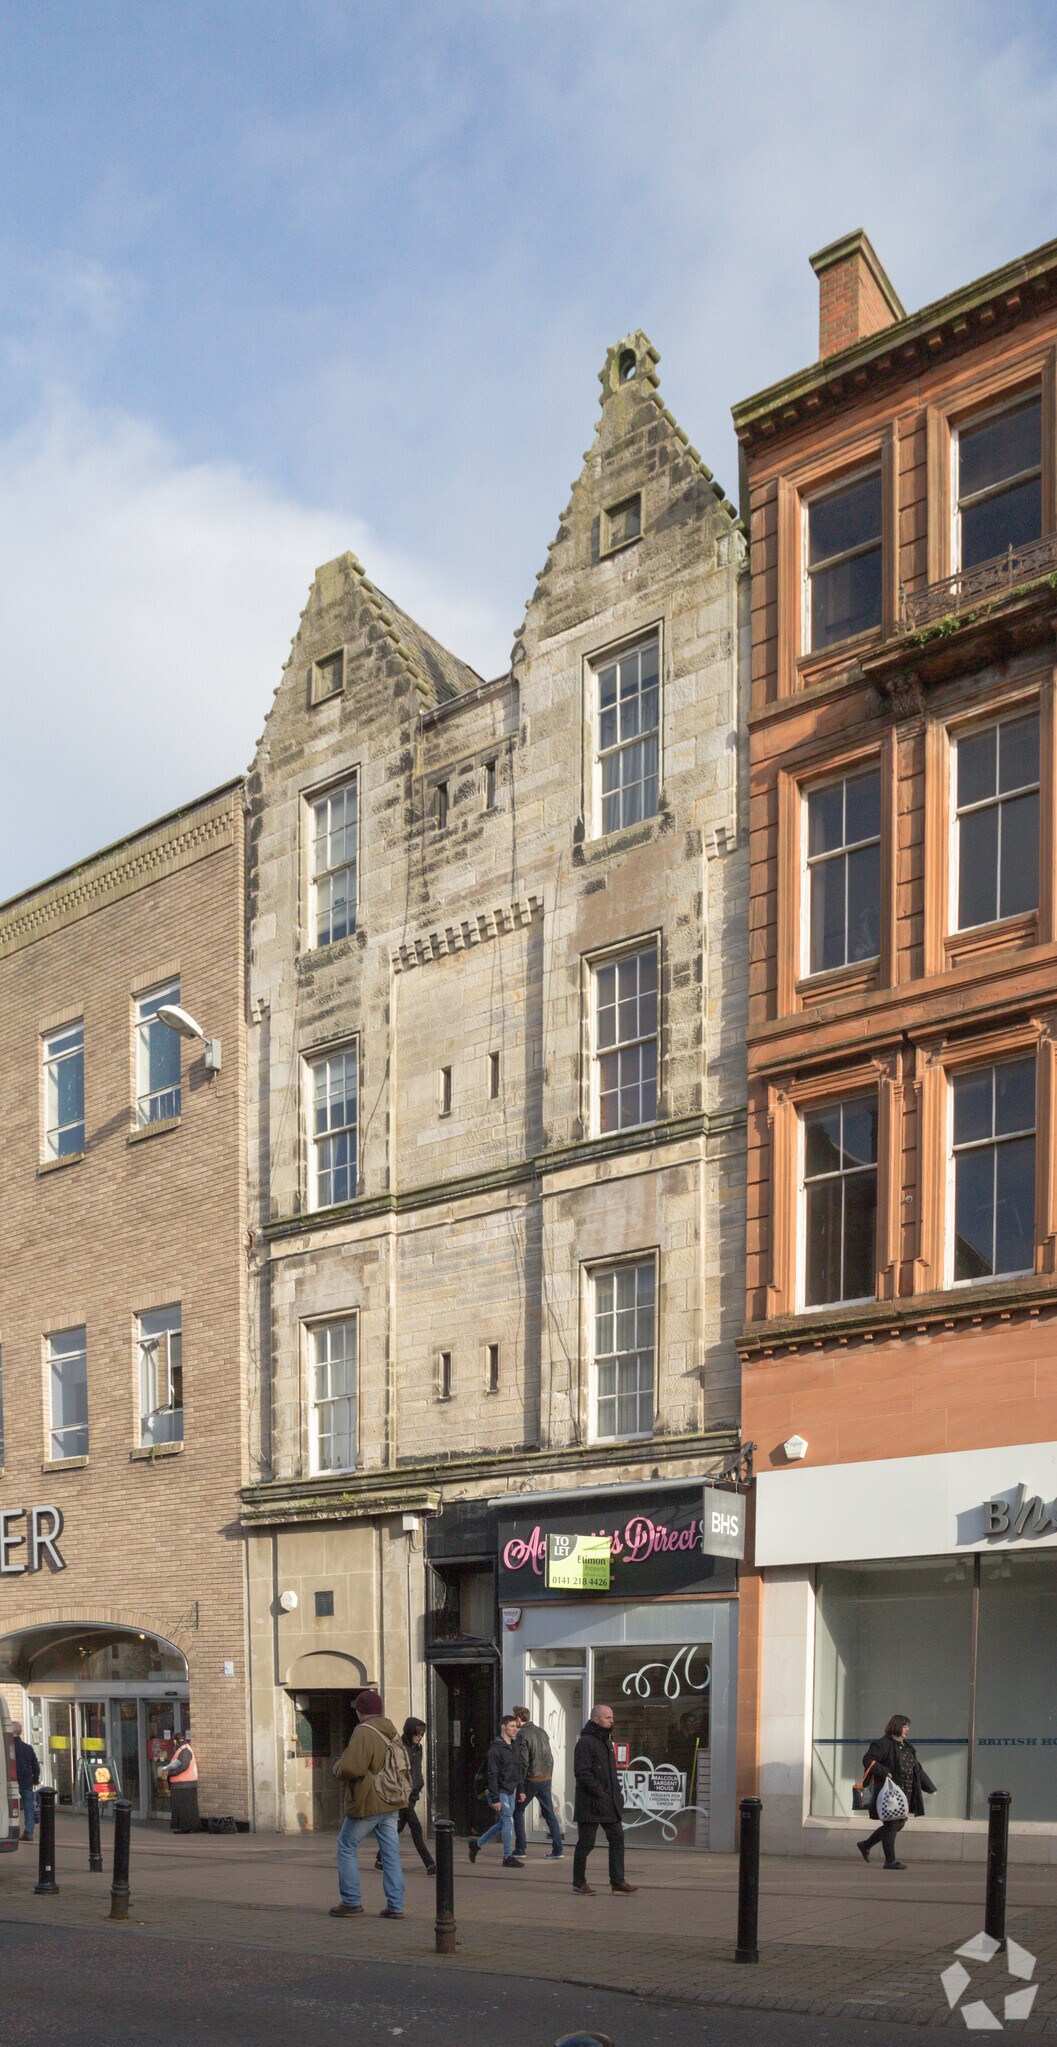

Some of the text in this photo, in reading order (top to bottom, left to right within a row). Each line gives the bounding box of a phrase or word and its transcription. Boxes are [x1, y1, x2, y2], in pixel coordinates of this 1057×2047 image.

[983, 1482, 1057, 1535] Bh
[711, 1511, 739, 1536] BHS
[0, 1505, 64, 1572] ER
[554, 1536, 569, 1546] TO
[623, 1516, 697, 1563] Direct
[554, 1546, 570, 1556] LET
[552, 1576, 608, 1586] 0141 218 4426
[977, 1738, 1037, 1746] BRITISH
